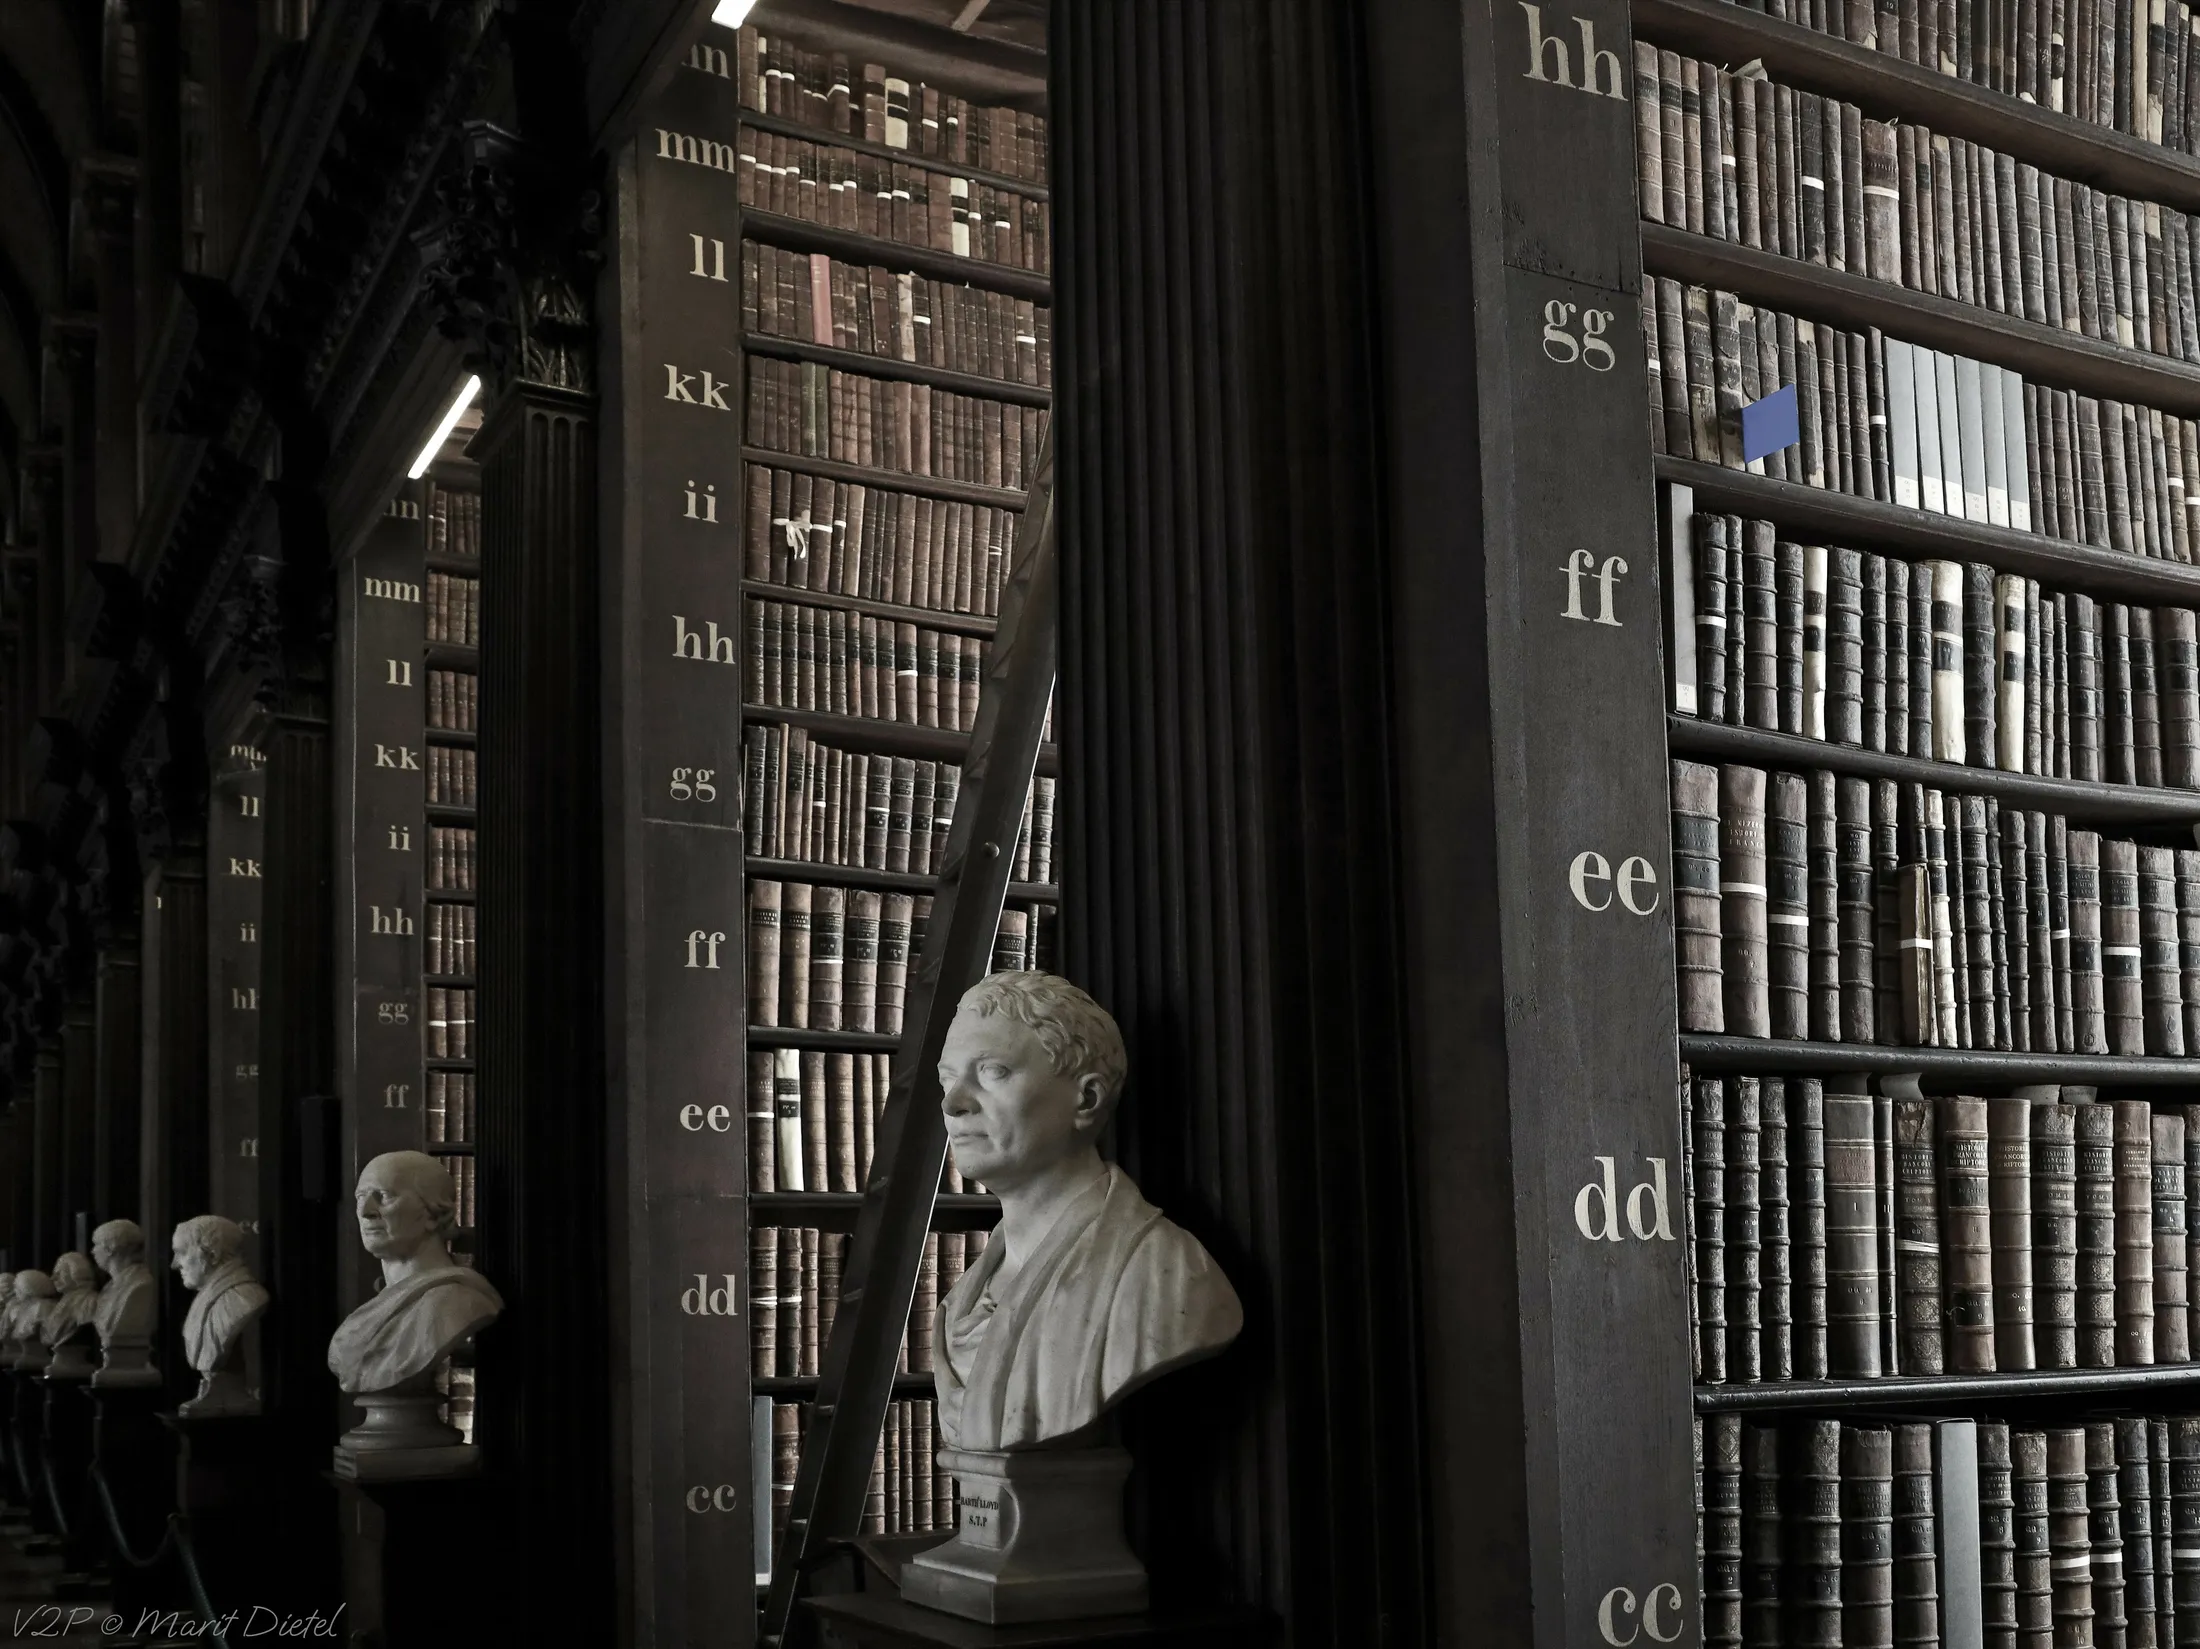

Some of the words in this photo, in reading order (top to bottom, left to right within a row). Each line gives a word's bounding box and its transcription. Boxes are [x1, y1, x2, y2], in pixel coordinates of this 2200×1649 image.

[1518, 1, 1629, 102] hh
[655, 128, 735, 174] mm
[690, 234, 728, 282] ll
[1543, 300, 1615, 371] gg
[664, 364, 730, 410] kk
[683, 479, 719, 524] ii
[366, 578, 419, 602] mm
[1559, 549, 1628, 626] ff
[673, 615, 735, 664] hh
[376, 744, 419, 769] kk
[670, 768, 716, 802] gg
[387, 824, 411, 851] ii
[230, 857, 262, 877] kk
[1569, 851, 1659, 915] ee
[240, 922, 256, 942] ii
[371, 906, 413, 935] hh
[685, 930, 725, 968] ff
[378, 1001, 410, 1026] gg
[384, 1084, 410, 1109] ff
[680, 1104, 730, 1132] ee
[1574, 1155, 1677, 1242] dd
[682, 1274, 737, 1315] dd
[687, 1485, 736, 1513] cc
[1598, 1583, 1683, 1647] cc
